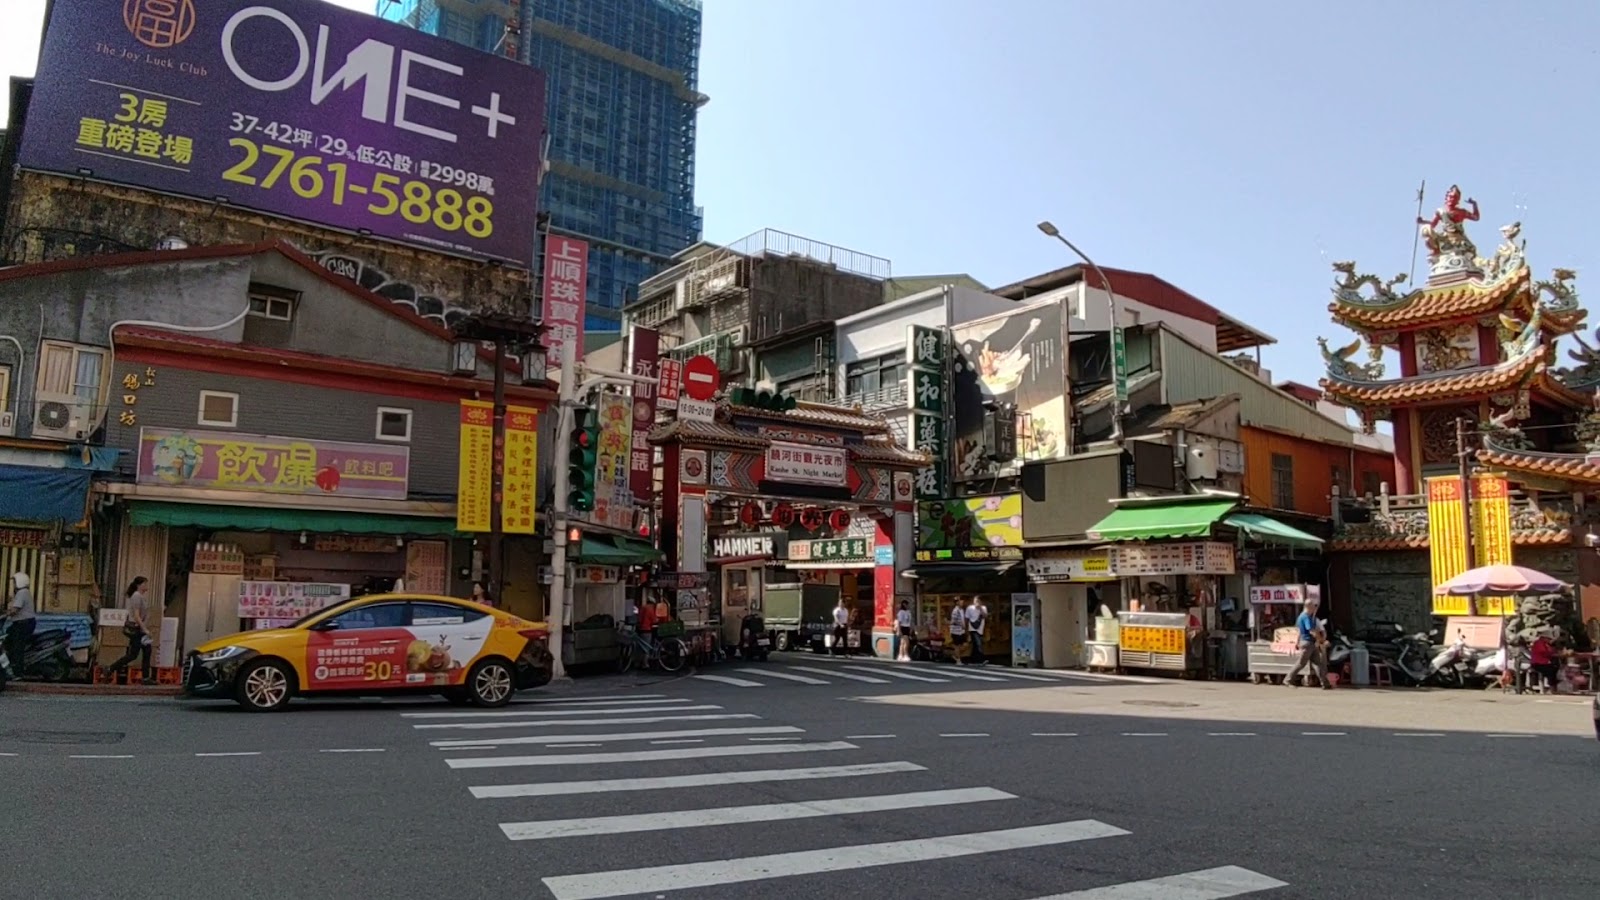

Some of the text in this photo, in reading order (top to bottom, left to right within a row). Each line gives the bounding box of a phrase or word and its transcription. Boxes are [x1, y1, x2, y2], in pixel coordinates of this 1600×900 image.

[96, 43, 208, 77] The Joy Luck Club
[114, 93, 168, 127] 3房
[76, 117, 193, 164] 重磅登場
[222, 137, 493, 238] 2761-5888
[145, 367, 156, 386] 松山
[216, 443, 317, 489] 飲爆
[345, 458, 394, 476] 飲料吧
[770, 450, 843, 467] 饒河街觀光夜市
[803, 469, 819, 478] Night
[822, 470, 843, 479] Market
[713, 537, 774, 557] HAMMER
